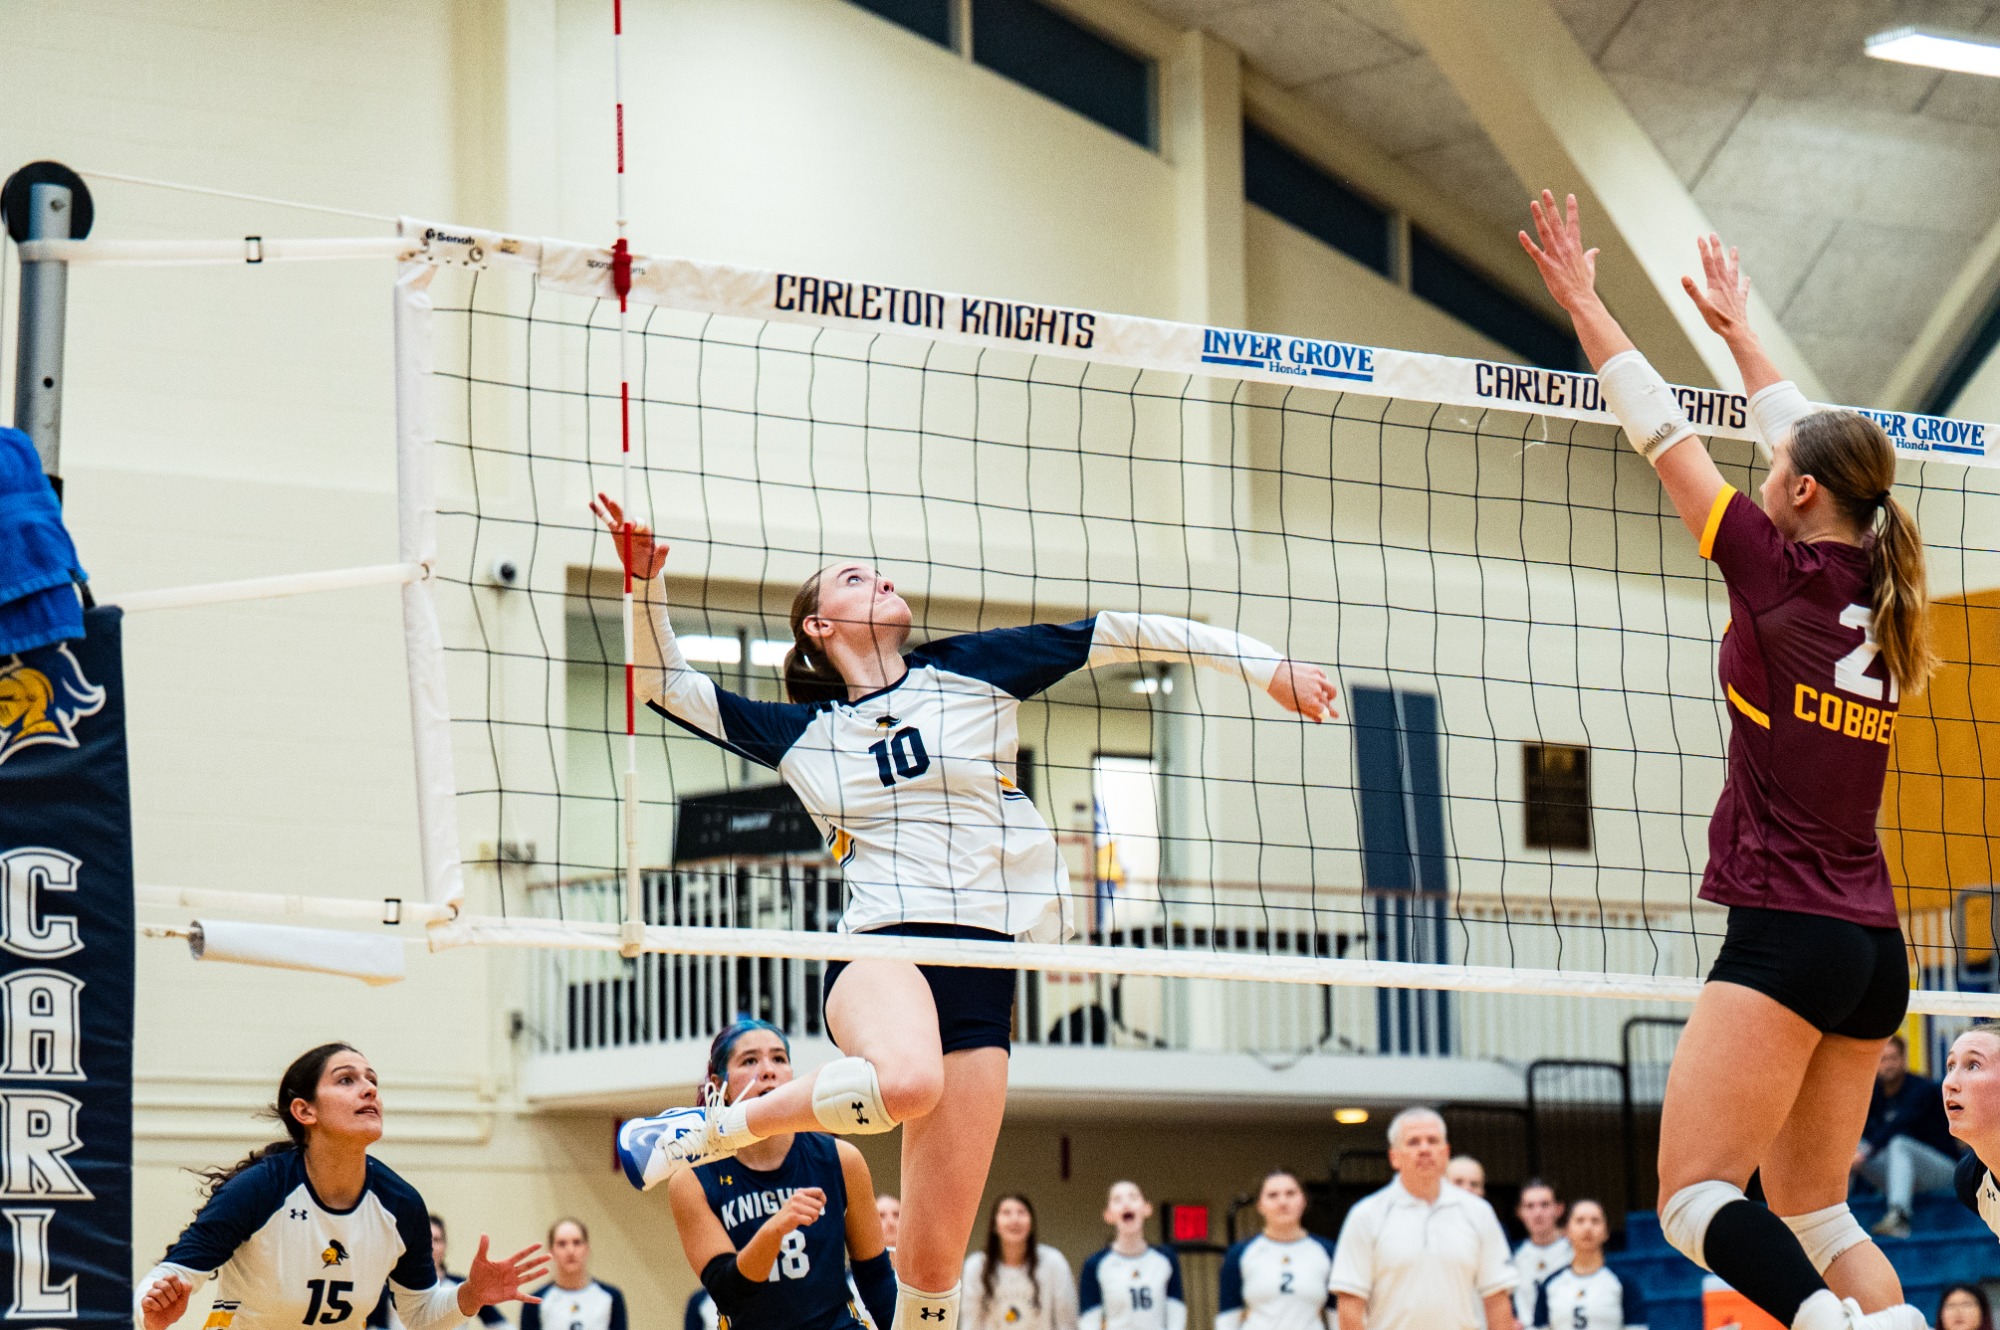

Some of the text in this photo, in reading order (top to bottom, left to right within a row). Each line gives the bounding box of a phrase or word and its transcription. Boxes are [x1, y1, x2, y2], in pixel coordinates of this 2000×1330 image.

[775, 273, 1096, 349] CARLETON KNIGHTS
[1202, 328, 1374, 373] INVER GROVE
[1269, 361, 1308, 377] Honda
[1475, 363, 1616, 413] CARLETO
[1896, 438, 1930, 451] Honda
[1912, 417, 1985, 447] GROVE
[1834, 602, 1899, 704] 2
[868, 726, 931, 787] 10
[302, 1278, 354, 1326] 15
[1280, 1272, 1294, 1294] 2
[1573, 1306, 1588, 1329] 5
